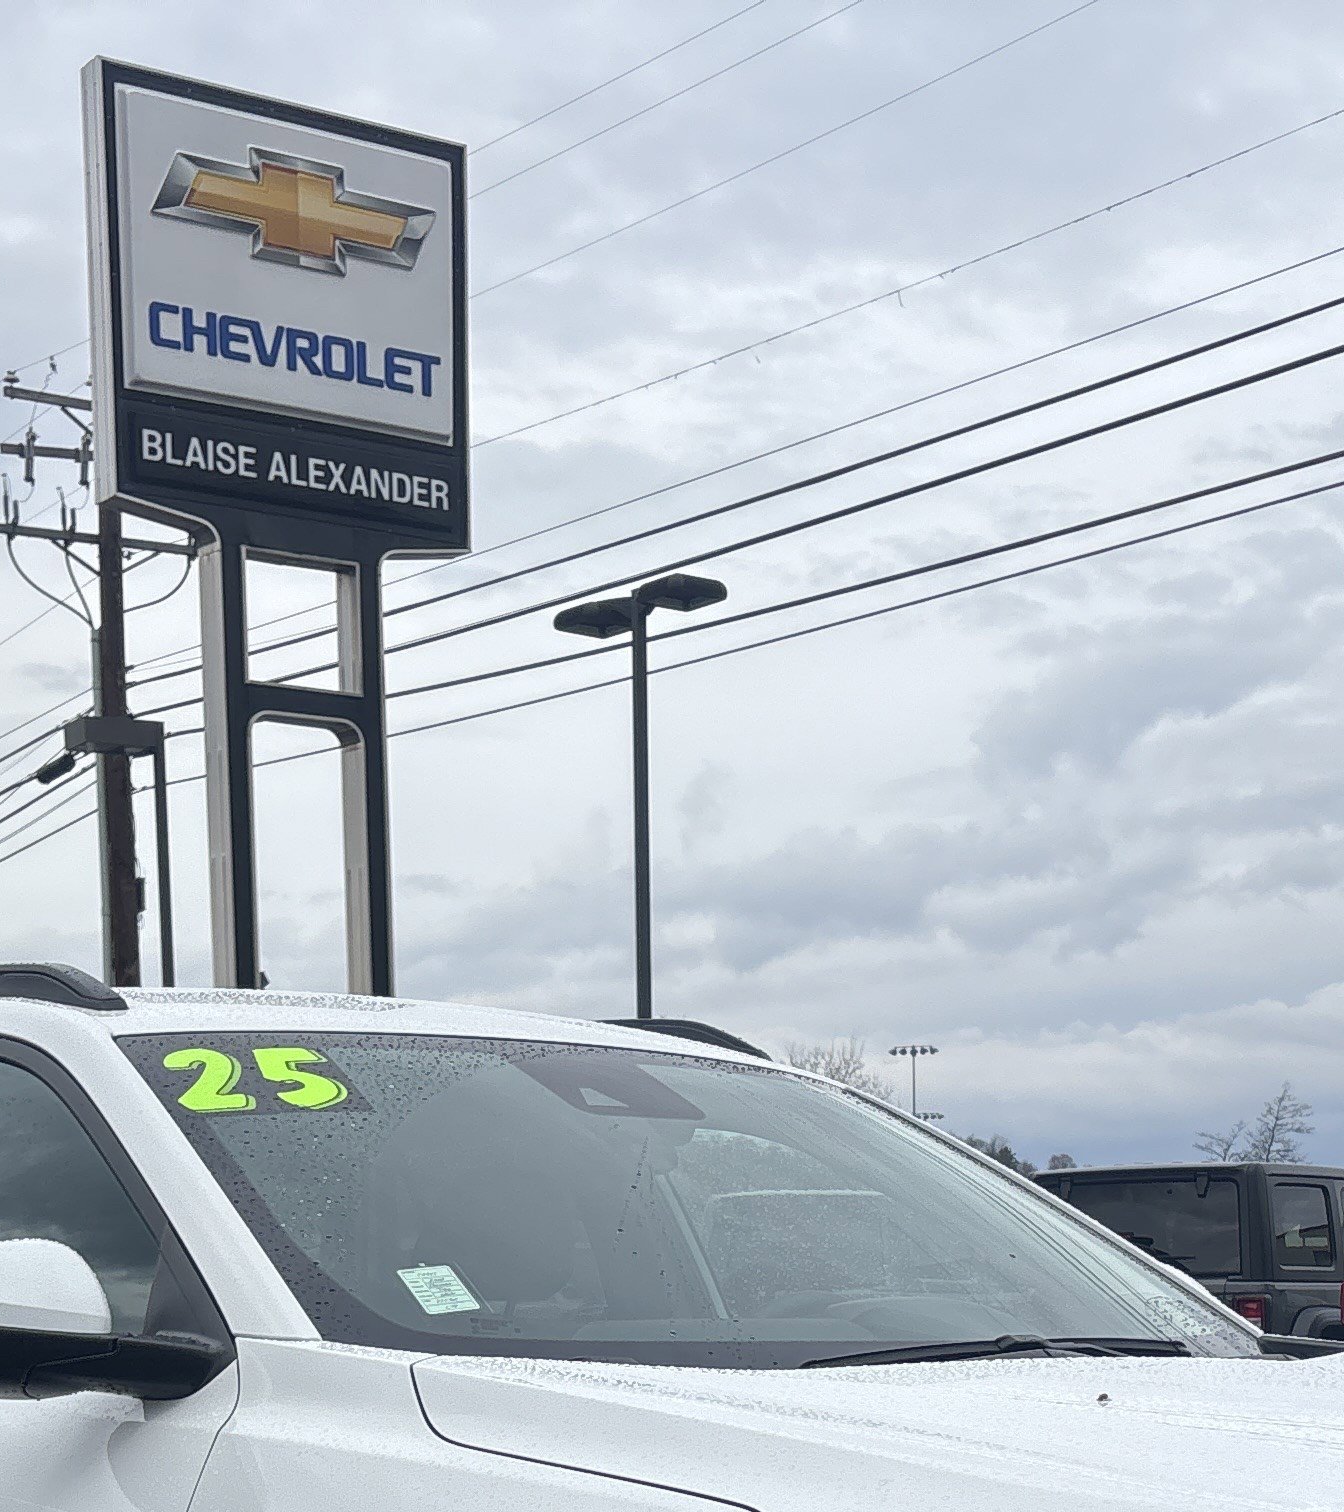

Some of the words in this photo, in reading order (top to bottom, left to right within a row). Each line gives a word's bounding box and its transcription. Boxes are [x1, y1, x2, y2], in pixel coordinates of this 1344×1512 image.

[149, 301, 441, 397] CHEVROLET
[141, 428, 258, 480] BLAISE
[267, 450, 450, 512] ALEXANDER
[162, 1046, 348, 1114] 25
